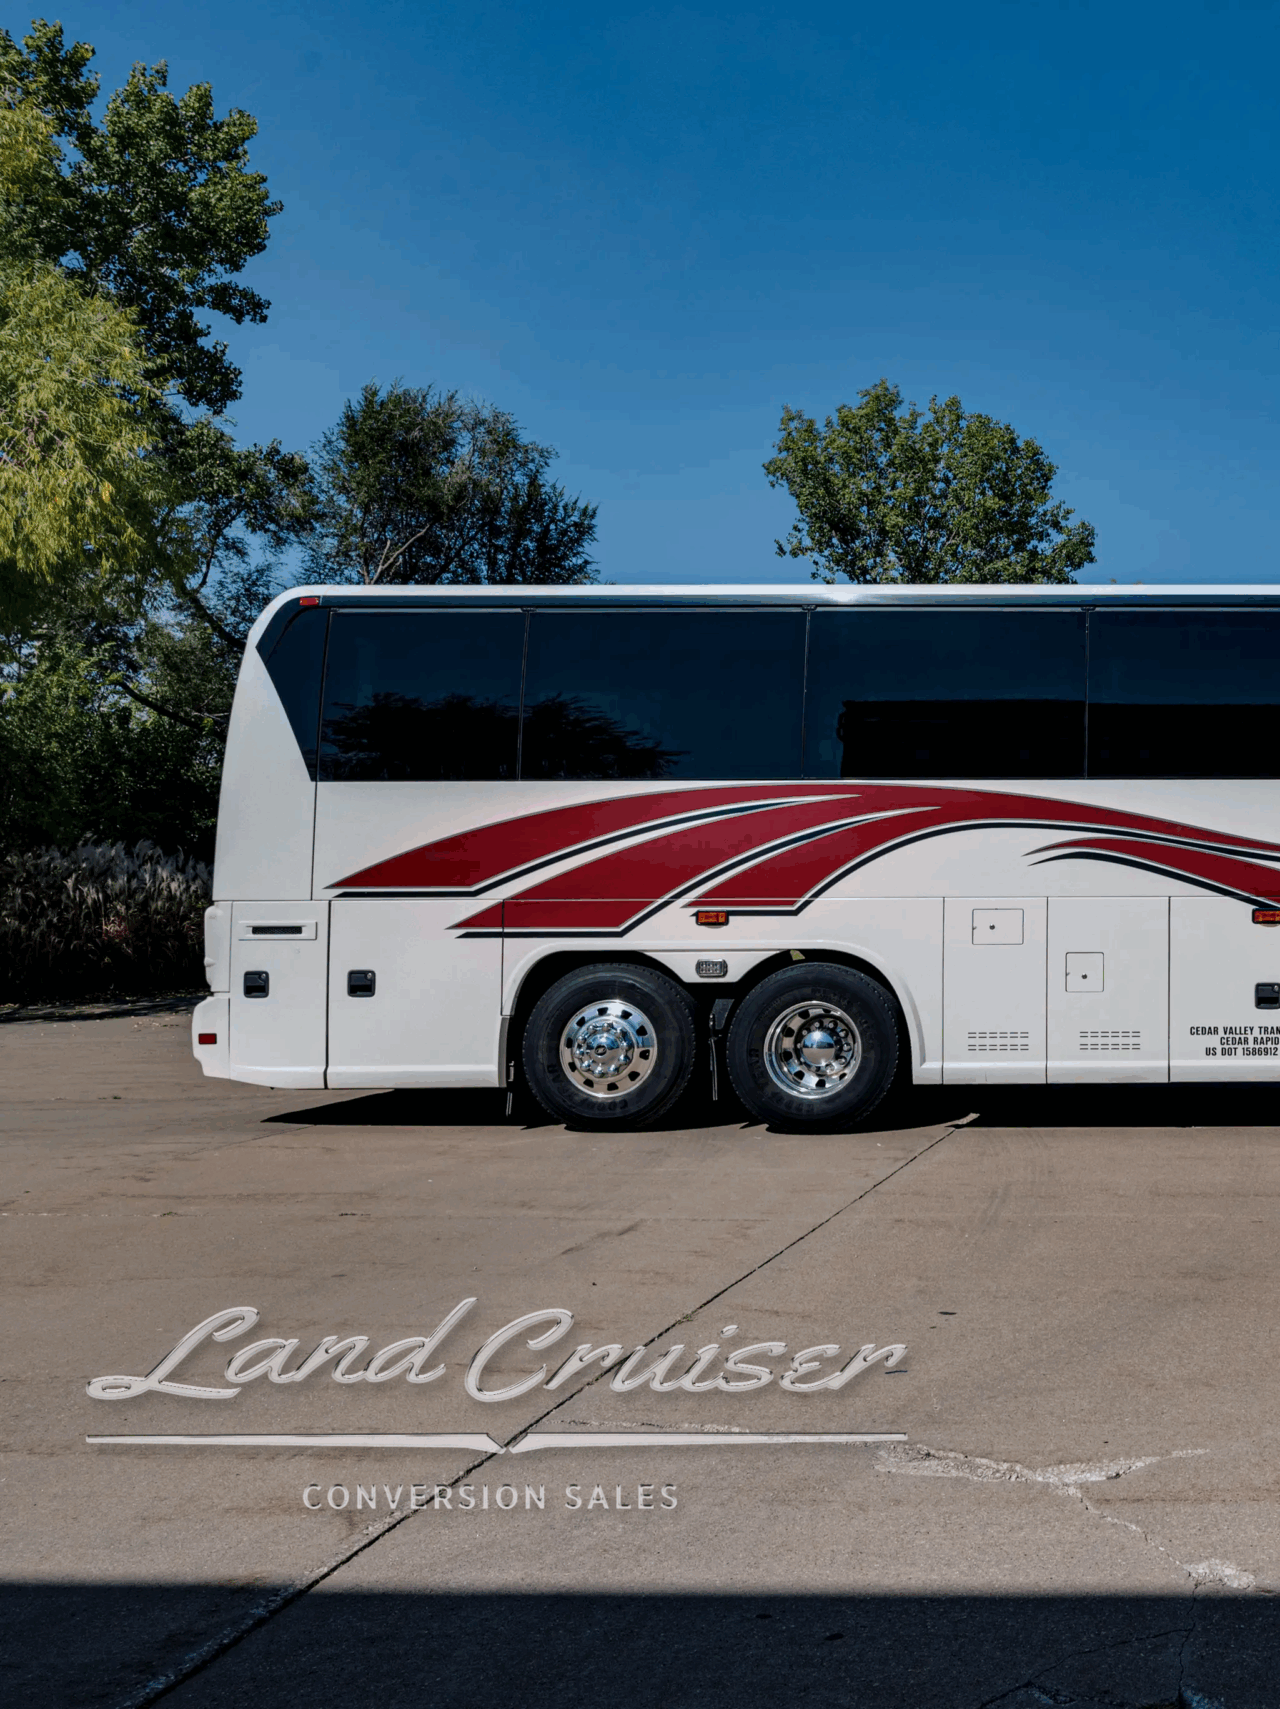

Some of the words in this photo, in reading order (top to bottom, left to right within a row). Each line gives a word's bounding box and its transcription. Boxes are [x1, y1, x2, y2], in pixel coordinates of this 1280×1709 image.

[1189, 1026, 1219, 1036] CEDAR
[1223, 1026, 1254, 1036] VALLEY
[1220, 1036, 1249, 1046] CEDAR
[1205, 1046, 1217, 1056] US
[1221, 1046, 1238, 1056] DOT
[1242, 1046, 1279, 1056] 1586912
